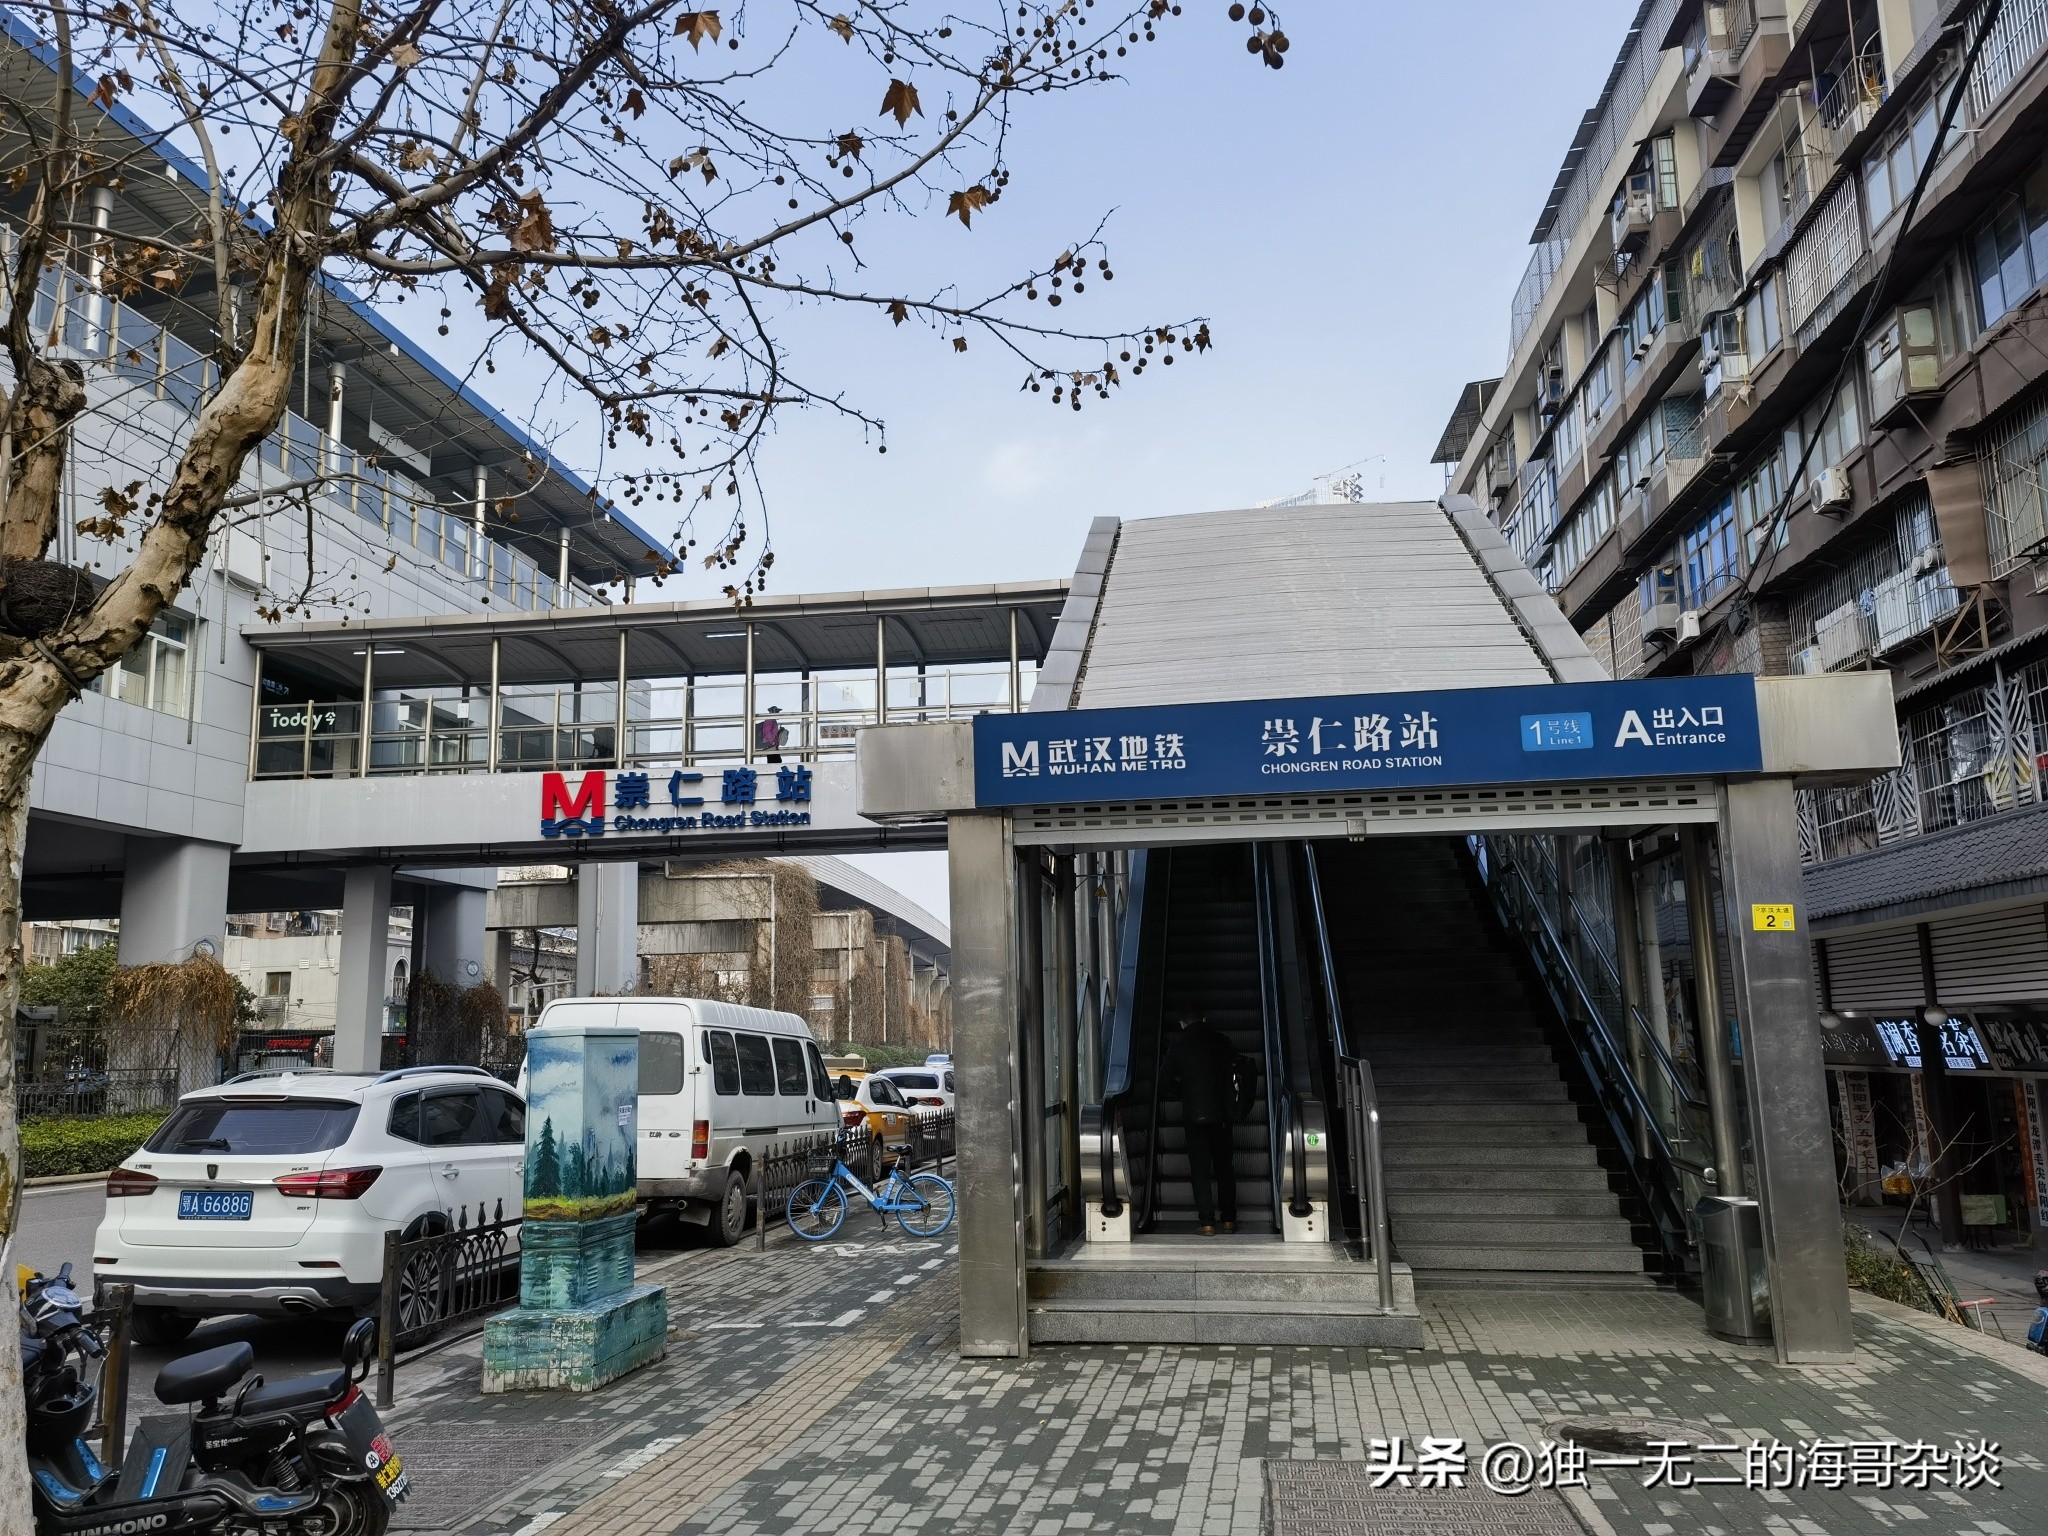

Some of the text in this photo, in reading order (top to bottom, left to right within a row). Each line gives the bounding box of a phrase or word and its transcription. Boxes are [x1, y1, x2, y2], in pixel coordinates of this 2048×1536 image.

[1614, 710, 1654, 748] A
[1653, 706, 1724, 729] 出入口
[1261, 711, 1438, 757] 崇仁路站
[1529, 719, 1581, 746] 1号线
[1549, 736, 1582, 745] Line 1
[1655, 731, 1726, 746] Entrance
[1048, 733, 1185, 764] 武汉地铁
[1048, 759, 1187, 775] WUHAN METRO
[1261, 755, 1442, 774] CHONGREN ROAD STATION
[614, 764, 812, 809] 崇仁路站
[614, 809, 811, 833] Chongren Road Station
[1766, 914, 1776, 927] 2
